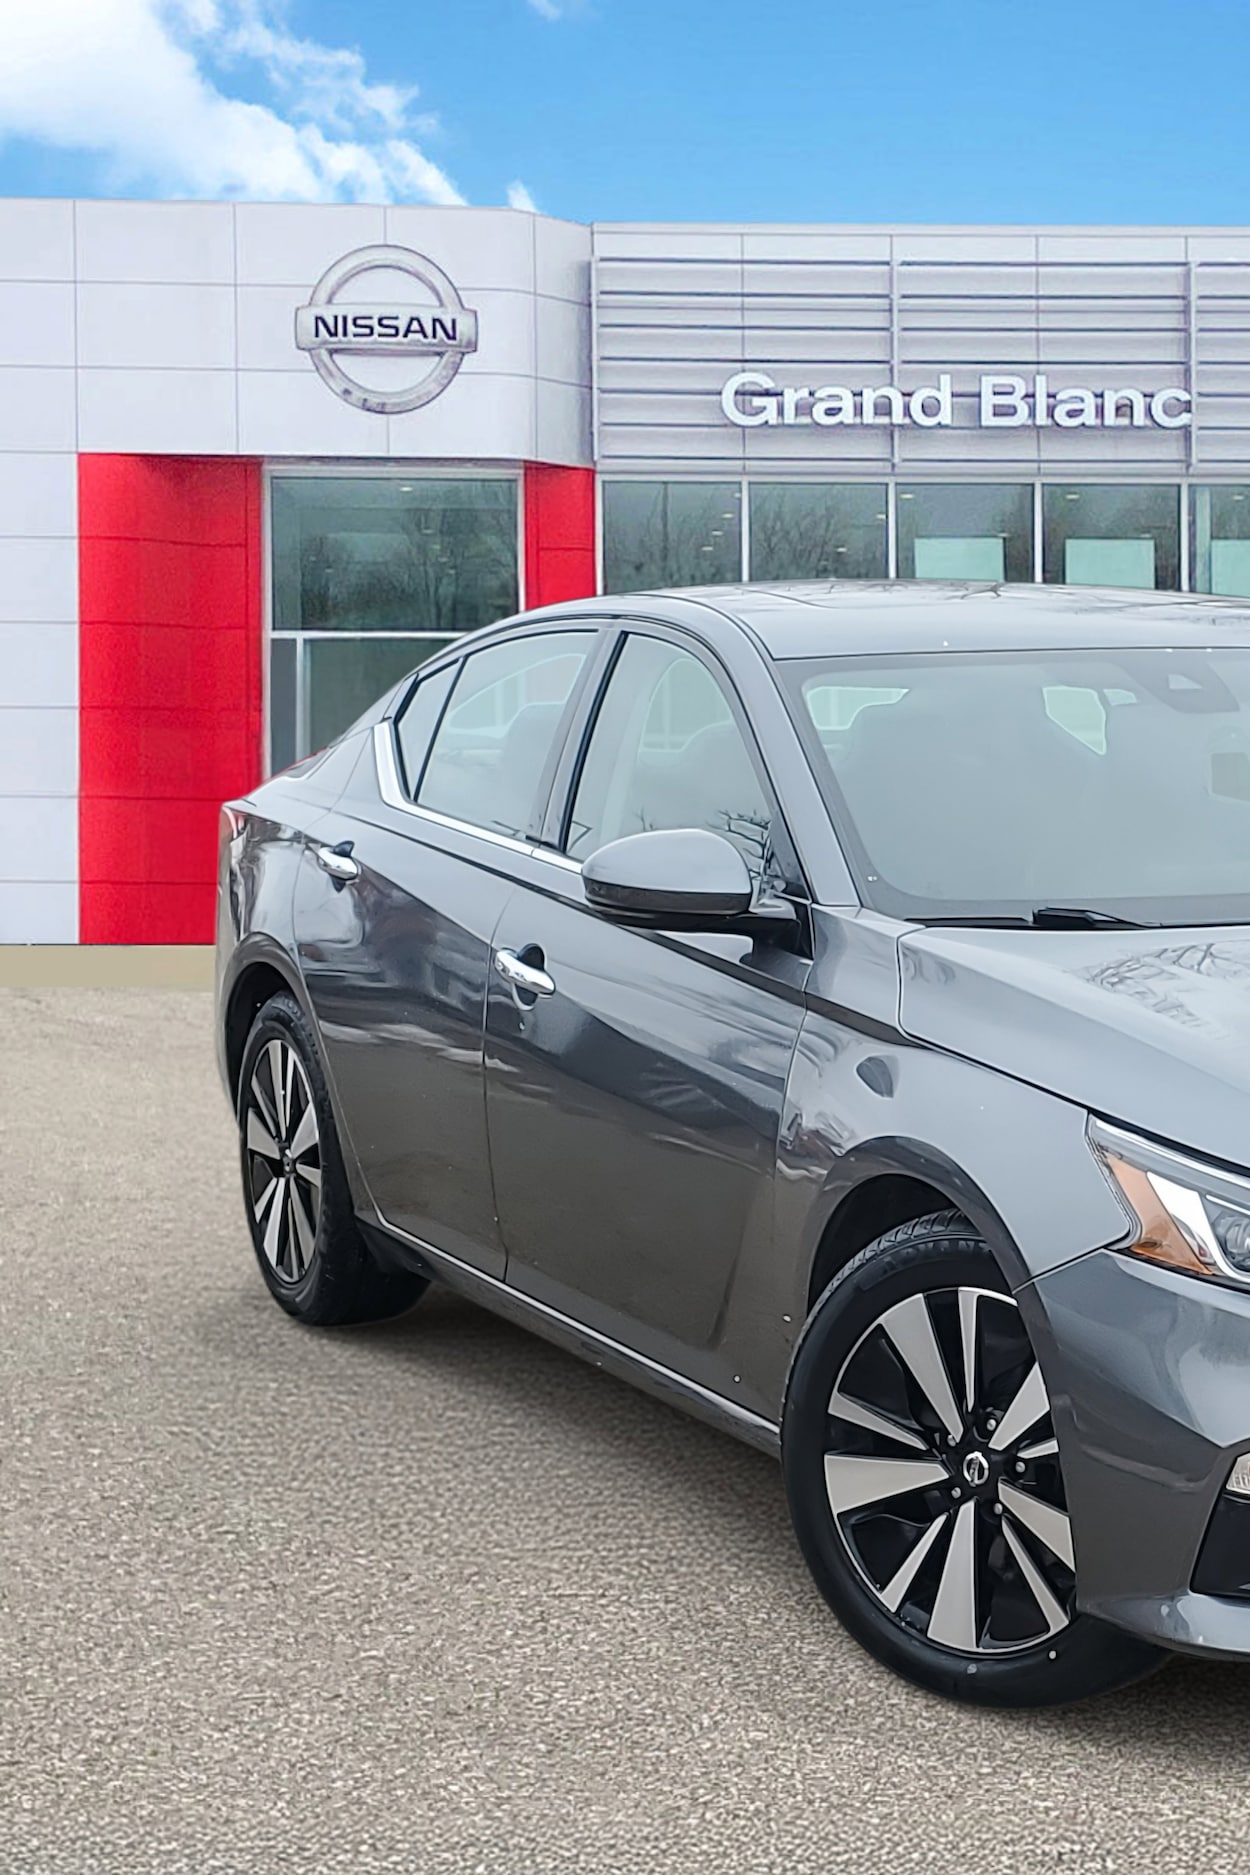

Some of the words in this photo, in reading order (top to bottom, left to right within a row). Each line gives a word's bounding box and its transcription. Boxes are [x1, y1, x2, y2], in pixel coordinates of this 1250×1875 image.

[314, 315, 457, 341] NISSAN
[720, 372, 952, 429] Grand
[980, 374, 1193, 429] Blanc
